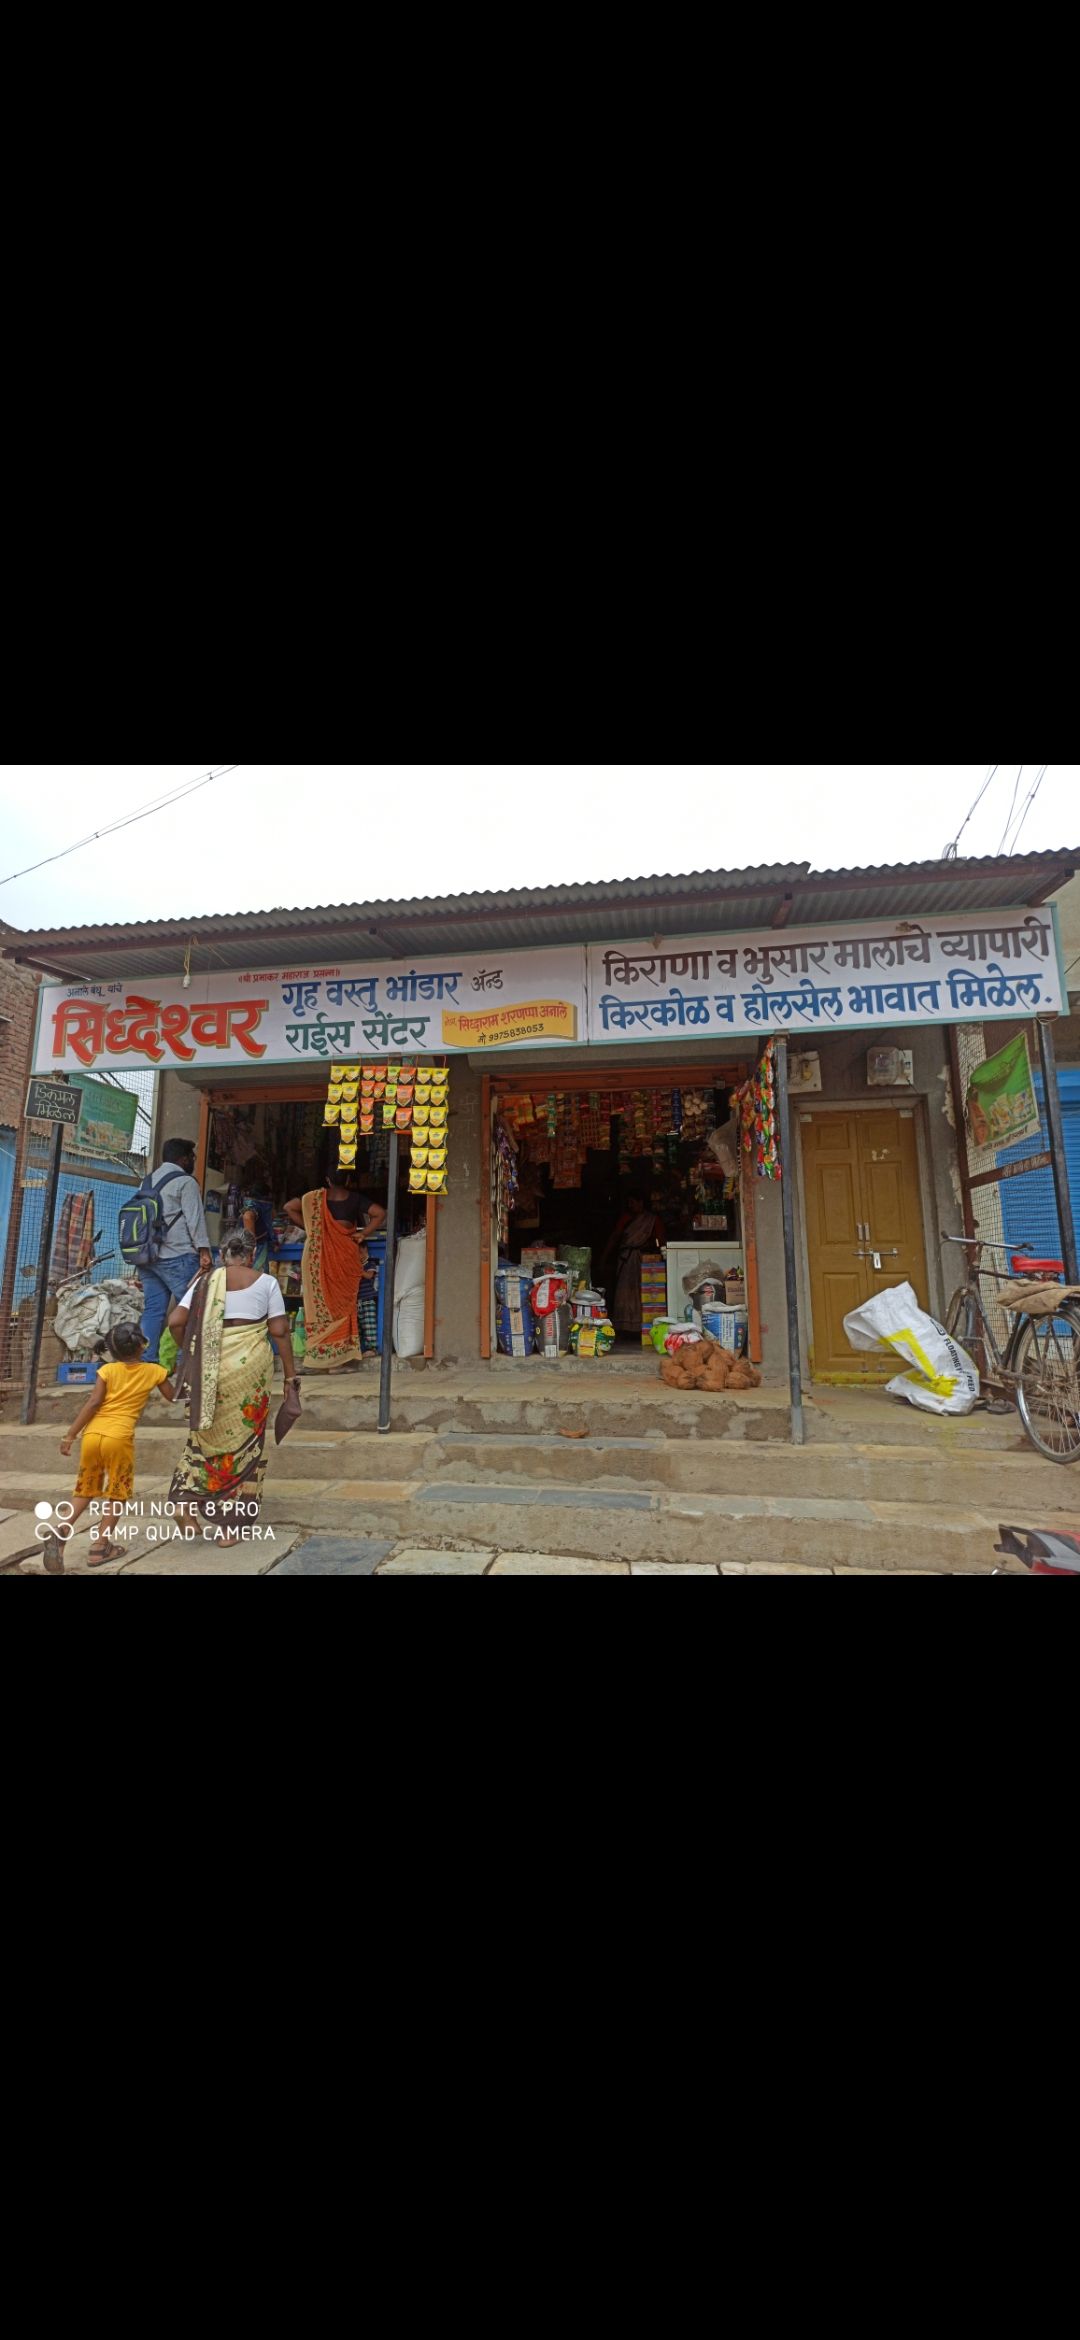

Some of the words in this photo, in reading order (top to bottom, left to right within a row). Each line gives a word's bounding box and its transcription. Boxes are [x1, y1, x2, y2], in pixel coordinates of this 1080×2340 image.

[602, 950, 713, 987] किराणा
[716, 949, 738, 978] व
[743, 941, 831, 985] भुसार
[832, 924, 932, 971] मालाचे
[936, 916, 1051, 962] व्यापारी
[281, 970, 310, 980] महाराज
[281, 981, 321, 1017] गृह
[326, 978, 379, 1013] वस्तु
[386, 969, 463, 1005] भांडार
[599, 988, 710, 1031] किरकोळ
[714, 994, 736, 1023] व
[740, 978, 842, 1025] होलसेल
[848, 980, 941, 1014] भावात
[946, 963, 1053, 1011] मिळेल.
[285, 1012, 355, 1056] राईस
[361, 1010, 431, 1048] सेंटर
[944, 1338, 962, 1368] FLOATING
[966, 1375, 976, 1392] FEED
